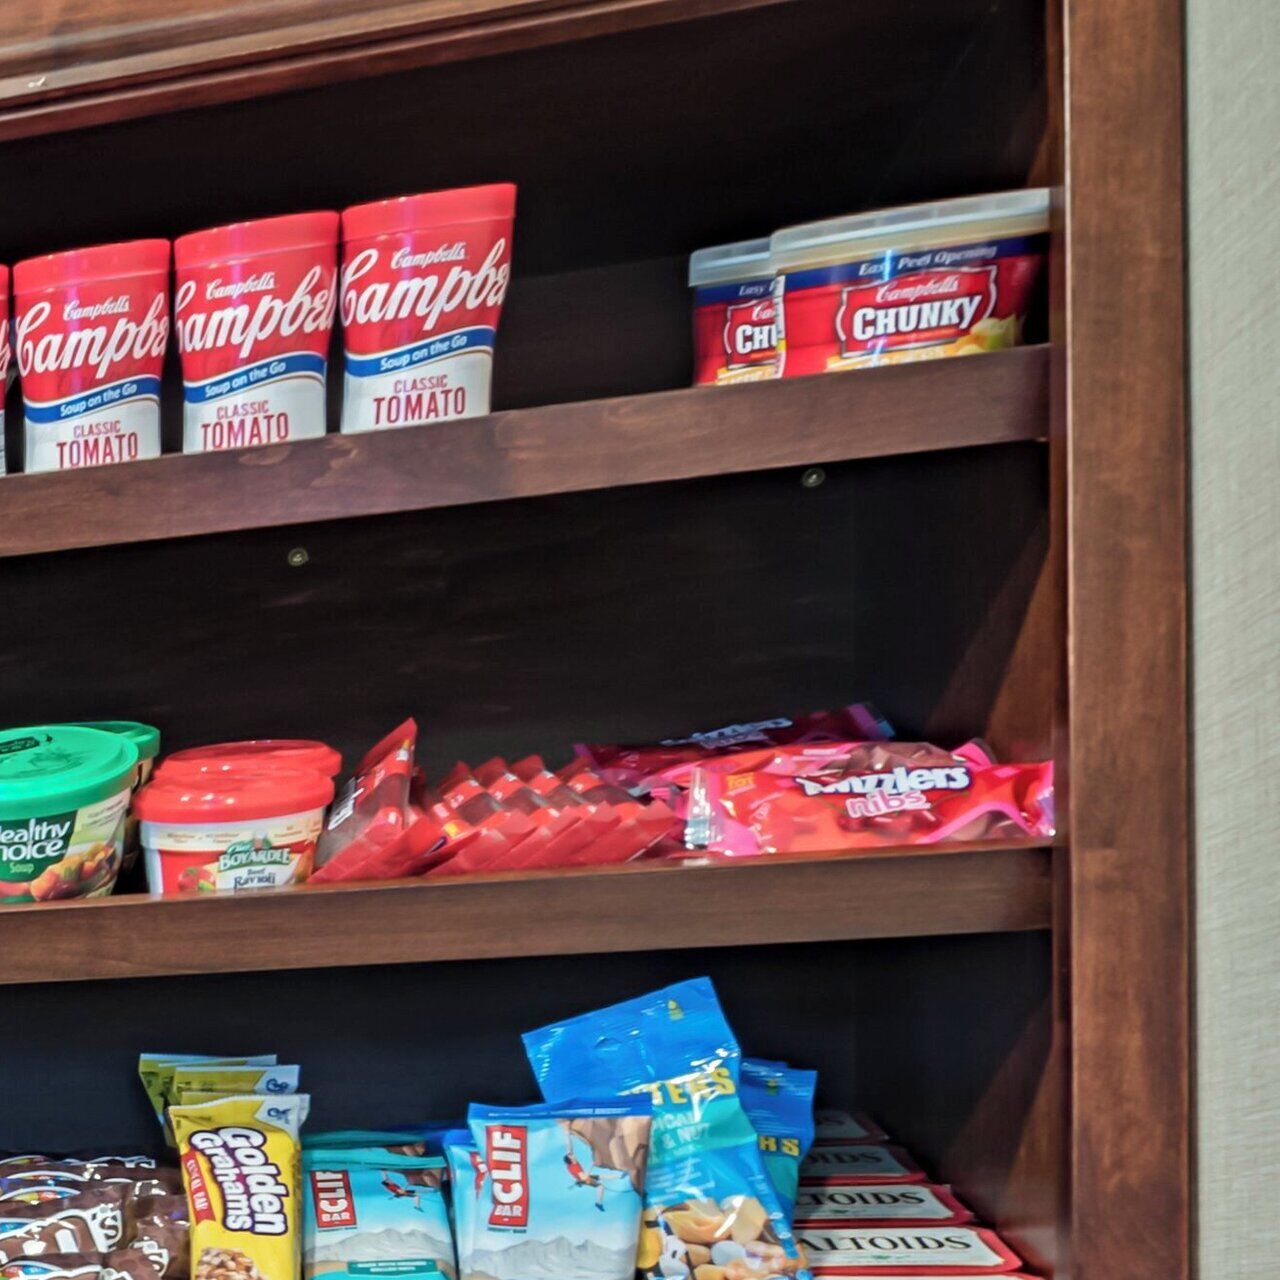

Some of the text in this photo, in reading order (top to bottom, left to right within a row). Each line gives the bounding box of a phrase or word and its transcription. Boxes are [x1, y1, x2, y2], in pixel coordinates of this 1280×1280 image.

[898, 247, 998, 270] Peel Opening
[853, 295, 982, 341] CHUNKY
[380, 335, 468, 371] Soup on the Go
[204, 361, 287, 398] Soup on the Go
[394, 374, 449, 395] CLASSIC
[60, 383, 138, 417] Soup on the Go
[216, 400, 269, 420] CLASSIC
[374, 386, 466, 426] TOMATO
[73, 420, 121, 438] CLASSIC
[201, 412, 289, 451] TOMATO
[56, 432, 138, 469] TOMATO
[845, 789, 930, 818] nibs
[9, 862, 35, 874] Soup
[219, 847, 290, 872] BOYARDEE
[234, 873, 276, 889] Ravioli
[190, 1132, 253, 1230] Grahams
[218, 1127, 287, 1235] Golden
[491, 1130, 524, 1204] CLIF
[316, 1170, 348, 1214] CLIF
[321, 1212, 352, 1223] BAR
[494, 1203, 523, 1217] BAR
[801, 1236, 973, 1252] ALTOIDS
